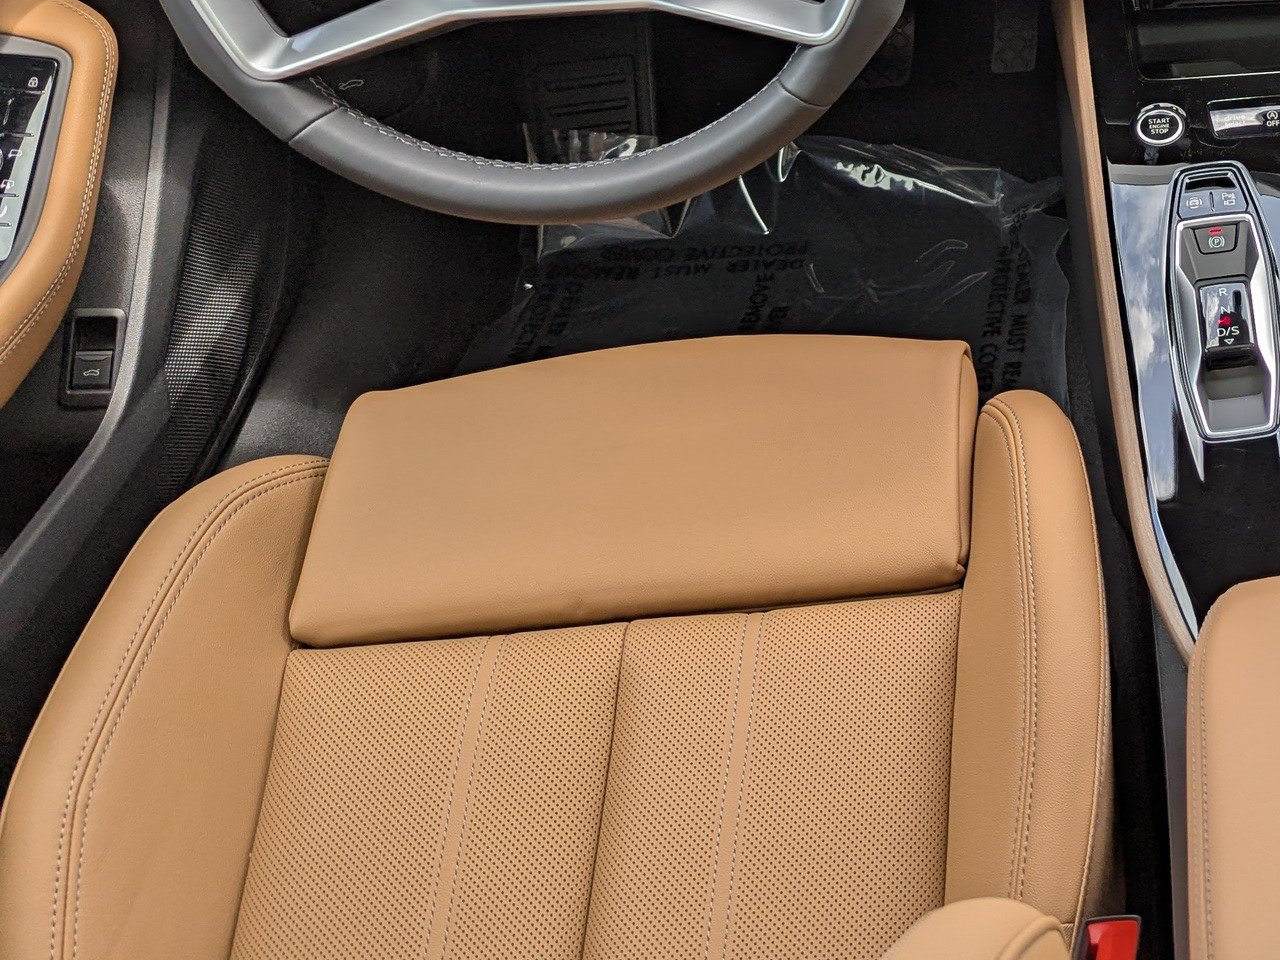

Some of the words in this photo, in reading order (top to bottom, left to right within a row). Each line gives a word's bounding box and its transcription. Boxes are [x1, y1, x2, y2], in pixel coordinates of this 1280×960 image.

[1148, 117, 1171, 125] START
[1218, 287, 1228, 297] R
[1220, 305, 1231, 315] N
[1006, 313, 1029, 354] MUST
[1216, 325, 1240, 337] D/S
[1001, 360, 1023, 390] REM
